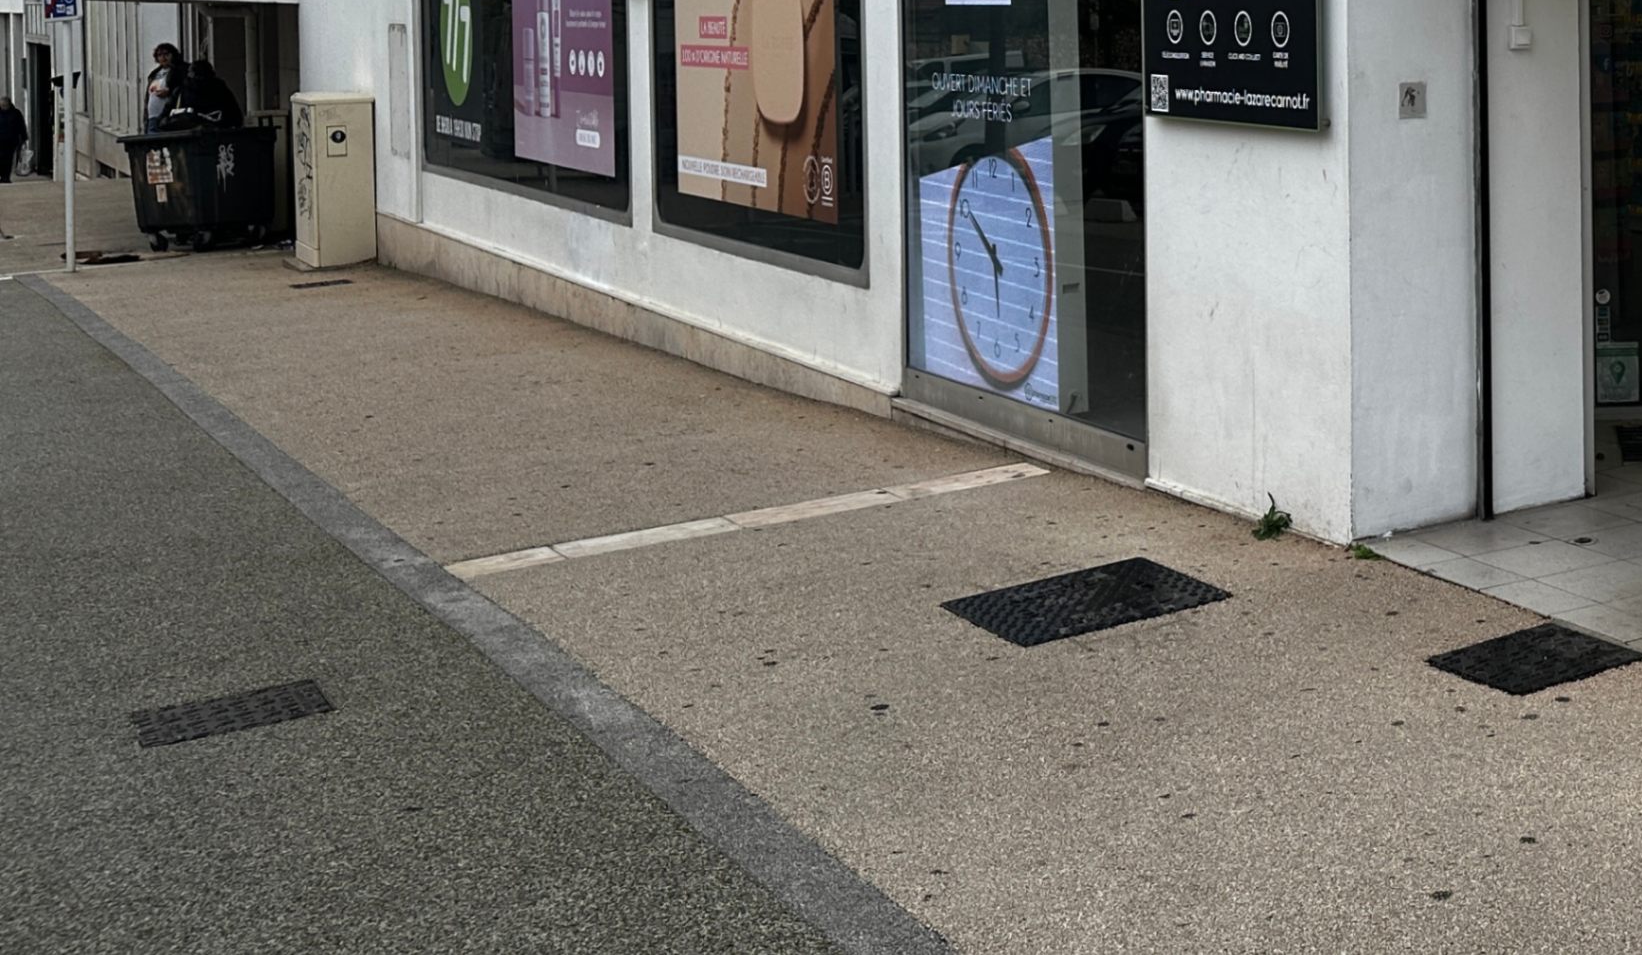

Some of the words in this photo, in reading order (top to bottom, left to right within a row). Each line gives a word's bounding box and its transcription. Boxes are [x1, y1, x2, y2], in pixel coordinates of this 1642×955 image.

[931, 72, 966, 92] OUVERT
[968, 74, 1018, 97] DIMANCHE
[1020, 78, 1032, 97] ET
[1175, 86, 1310, 110] www.pharmacie-lazarecarnot.fr
[951, 99, 980, 119] JOURS
[982, 96, 1012, 123] FÉRIÉS
[988, 158, 997, 178] 12
[971, 169, 978, 188] 11
[1011, 172, 1015, 192] 1
[960, 198, 970, 219] 10
[1026, 207, 1032, 228] 2
[955, 242, 961, 261] 9
[1033, 257, 1040, 277] 3
[1028, 306, 1035, 321] 4
[976, 321, 981, 339] 7
[993, 339, 1000, 357] 6
[1014, 333, 1020, 352] 5
